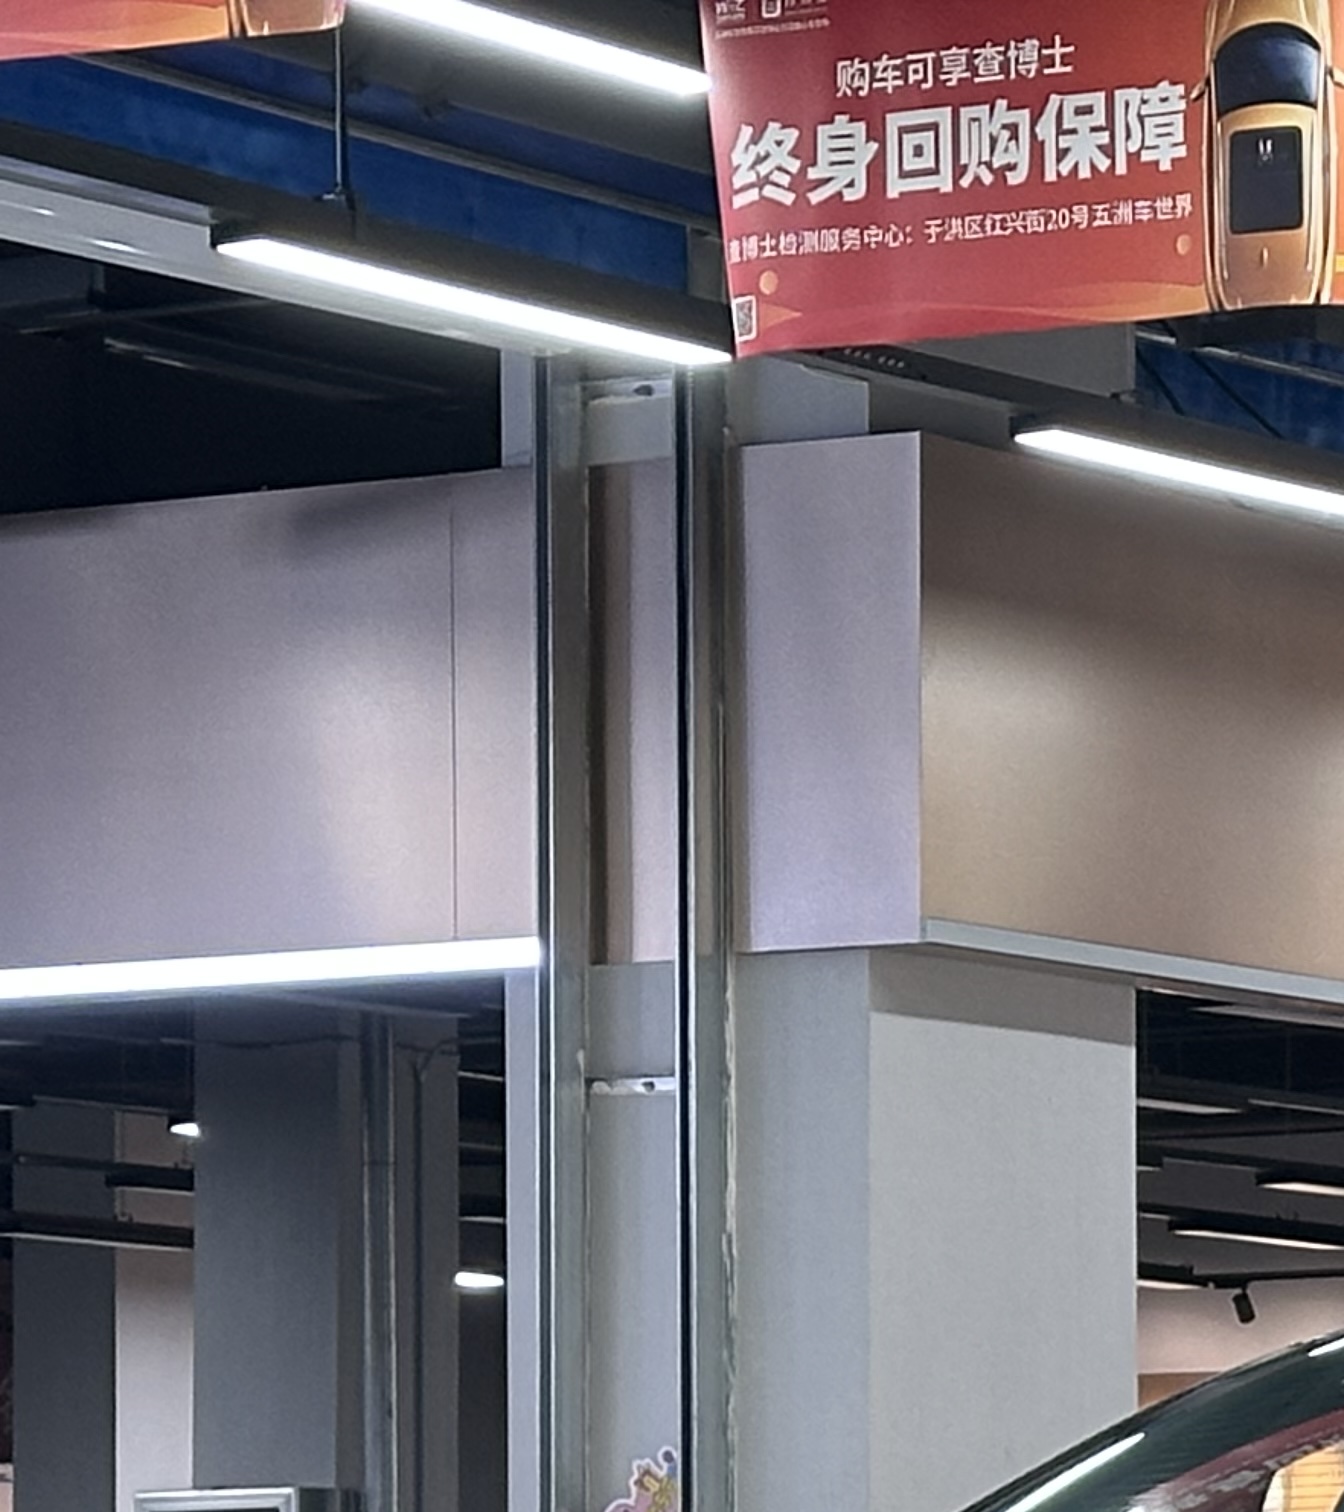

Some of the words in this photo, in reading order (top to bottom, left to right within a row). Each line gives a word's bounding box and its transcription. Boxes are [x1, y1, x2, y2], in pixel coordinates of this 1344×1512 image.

[836, 35, 1075, 97] 购车可享查博士
[730, 81, 1189, 210] 终身回购保障
